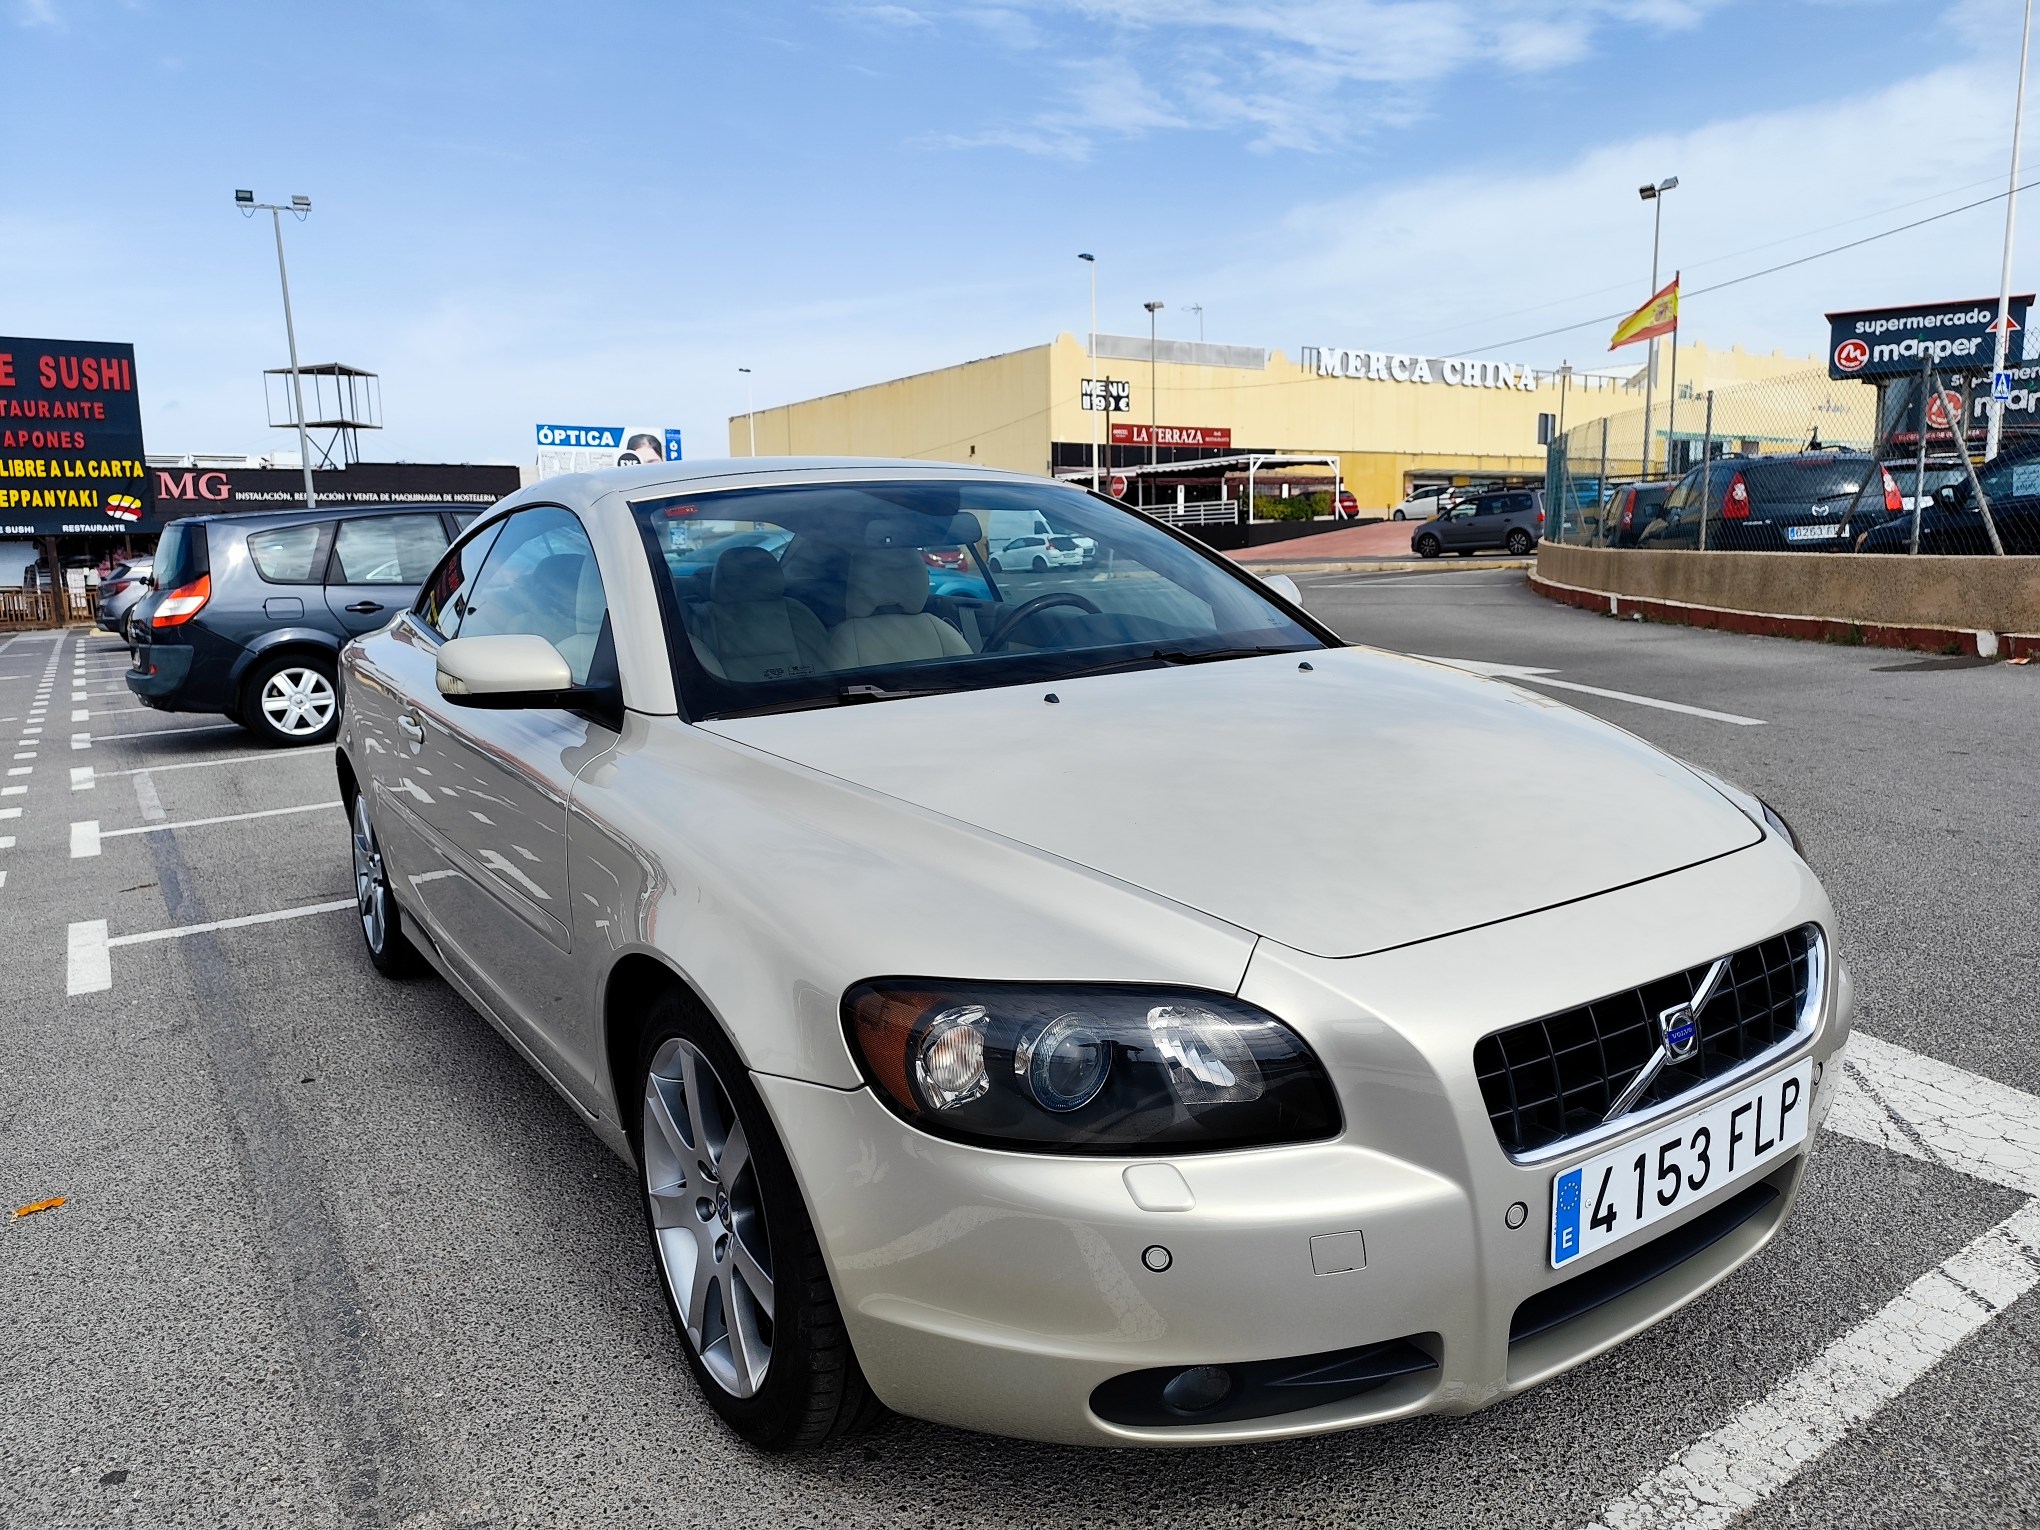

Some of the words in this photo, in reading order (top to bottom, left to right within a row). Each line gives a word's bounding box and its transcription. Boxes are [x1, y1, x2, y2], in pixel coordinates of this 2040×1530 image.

[1855, 308, 1991, 336] supermercado
[1873, 337, 1982, 364] manper
[39, 355, 131, 391] SUSHI
[1317, 347, 1433, 383] MERCA
[1442, 358, 1537, 391] CHINA
[1082, 379, 1129, 397] MENÚ
[4, 430, 85, 449] APONES
[538, 426, 615, 446] ÓPTICA
[1133, 427, 1149, 442] LA
[1149, 427, 1203, 444] TERRAZA
[0, 459, 46, 478] LIBRE
[50, 460, 62, 478] A
[64, 460, 86, 478] LA
[88, 460, 144, 478] CARTA
[156, 471, 232, 501] MG
[0, 490, 98, 508] EPPANYAKI
[235, 490, 293, 501] INSTALACIÓN,
[346, 492, 353, 501] Y
[353, 493, 379, 501] VENTA
[380, 492, 390, 501] DE
[391, 493, 442, 502] MAQUINARIA
[443, 493, 453, 502] DE
[5, 525, 35, 534] SUSHI
[62, 524, 126, 533] RESTAURANTE
[1671, 1027, 1693, 1039] VOLVO
[1589, 1126, 1712, 1234] 4153
[1728, 1076, 1801, 1173] FLP
[1562, 1226, 1573, 1249] E
